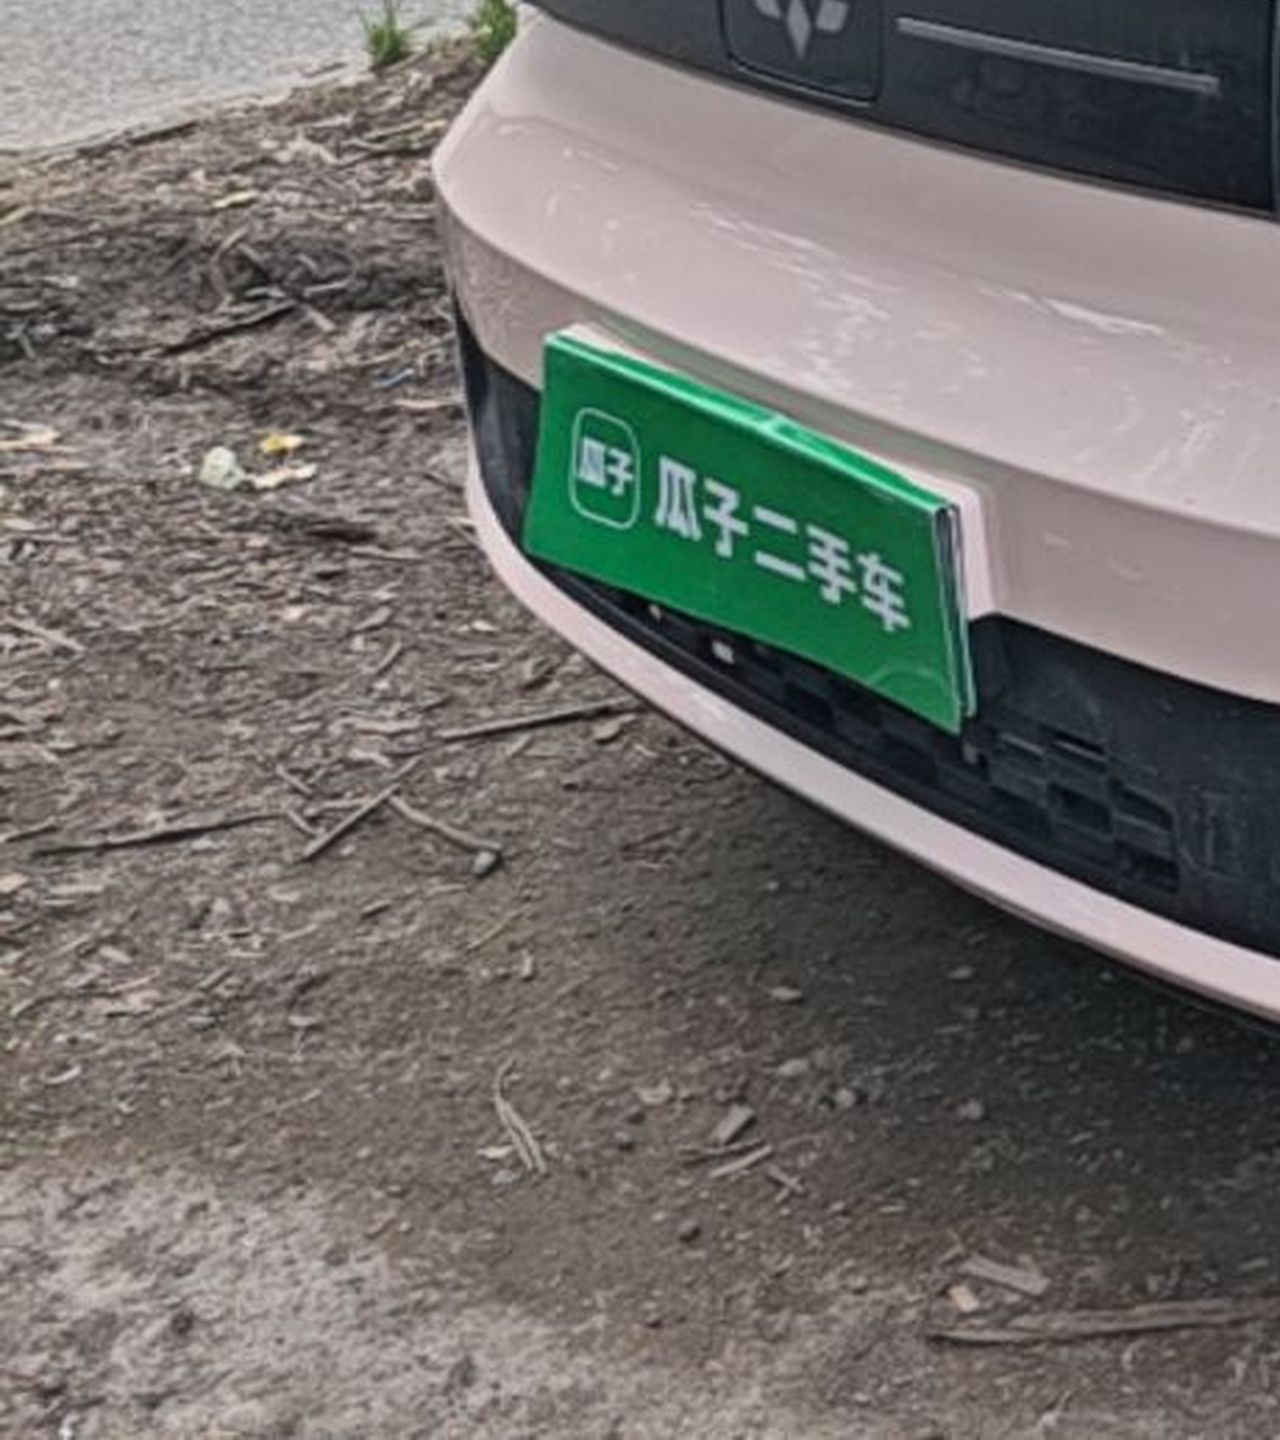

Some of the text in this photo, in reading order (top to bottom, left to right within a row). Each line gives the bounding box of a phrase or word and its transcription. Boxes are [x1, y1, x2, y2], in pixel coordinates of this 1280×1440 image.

[654, 455, 911, 633] 瓜子二手车
